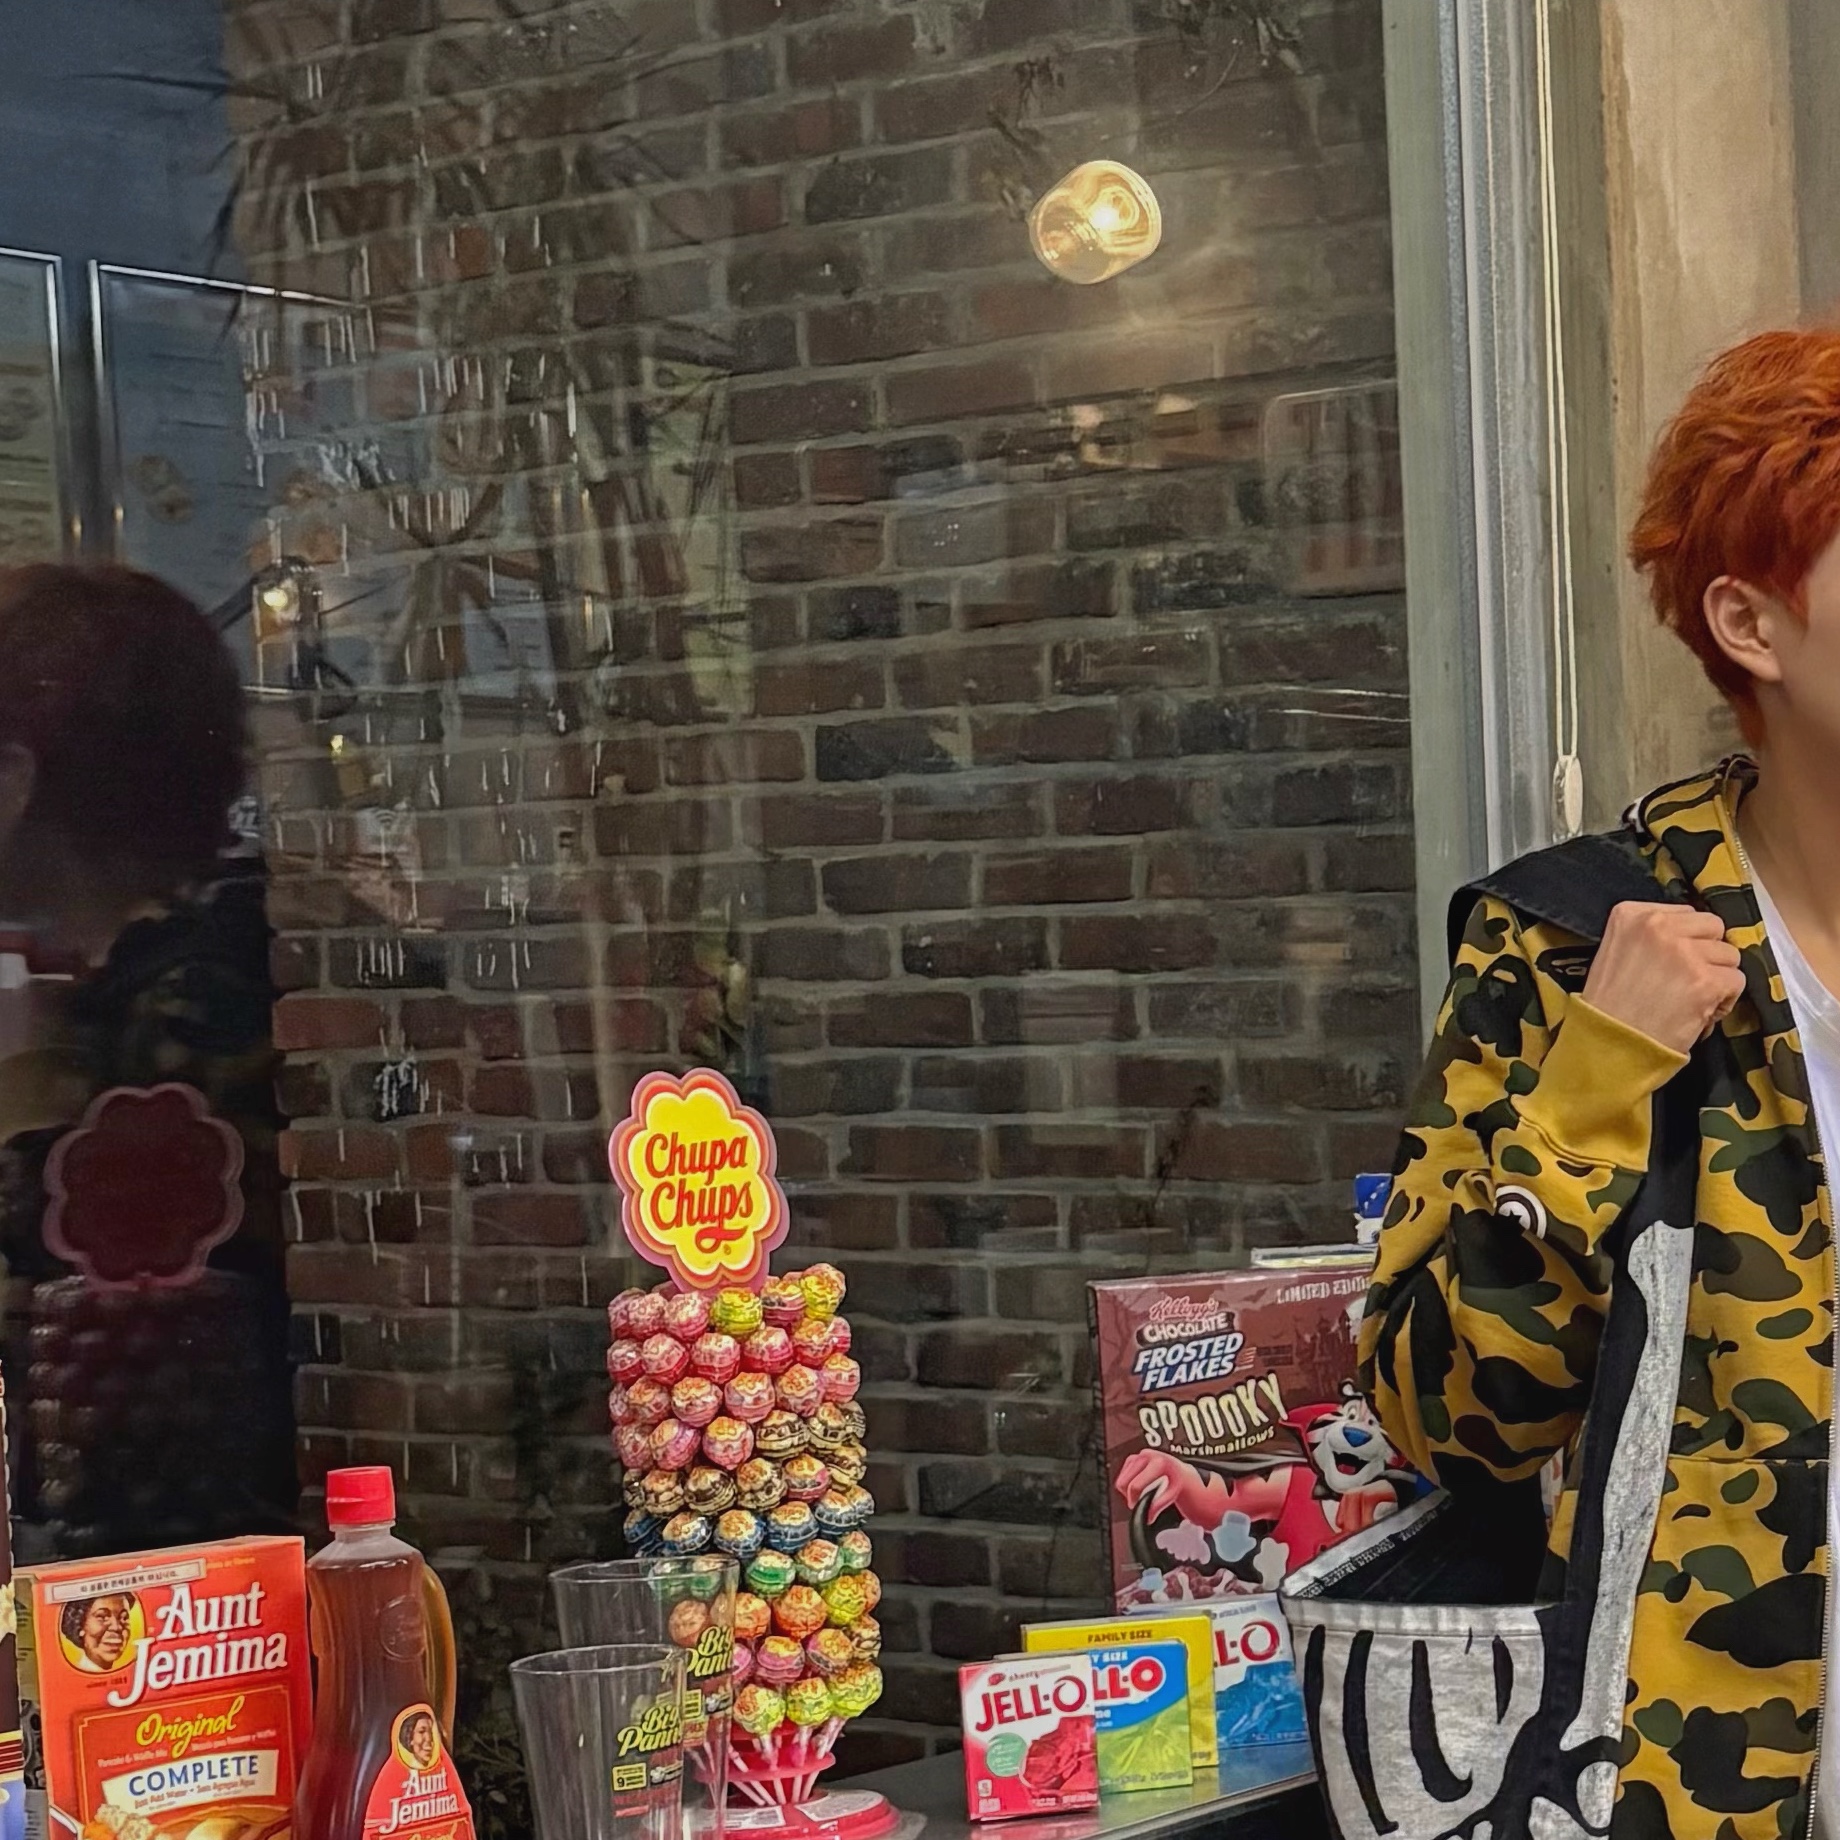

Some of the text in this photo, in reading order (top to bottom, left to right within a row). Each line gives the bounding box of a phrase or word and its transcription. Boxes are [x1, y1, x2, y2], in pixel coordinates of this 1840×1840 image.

[644, 1131, 749, 1186] Chupa
[649, 1181, 754, 1240] Chups
[1143, 1313, 1229, 1343] CHOCOLATE
[1150, 1297, 1219, 1322] Kellogg's
[1134, 1331, 1244, 1374] FROSTED
[1141, 1356, 1237, 1393] FLAKES
[1138, 1372, 1289, 1448] SPOOKY
[1169, 1426, 1276, 1457] Marshmallows
[156, 1582, 265, 1641] Aunt
[1087, 1628, 1153, 1643] FAMILY SIZE
[107, 1632, 288, 1707] Jemima
[136, 1695, 245, 1758] Original
[129, 1755, 259, 1797] COMPLETE
[401, 1766, 448, 1800] Aunt
[379, 1793, 459, 1834] Jemima
